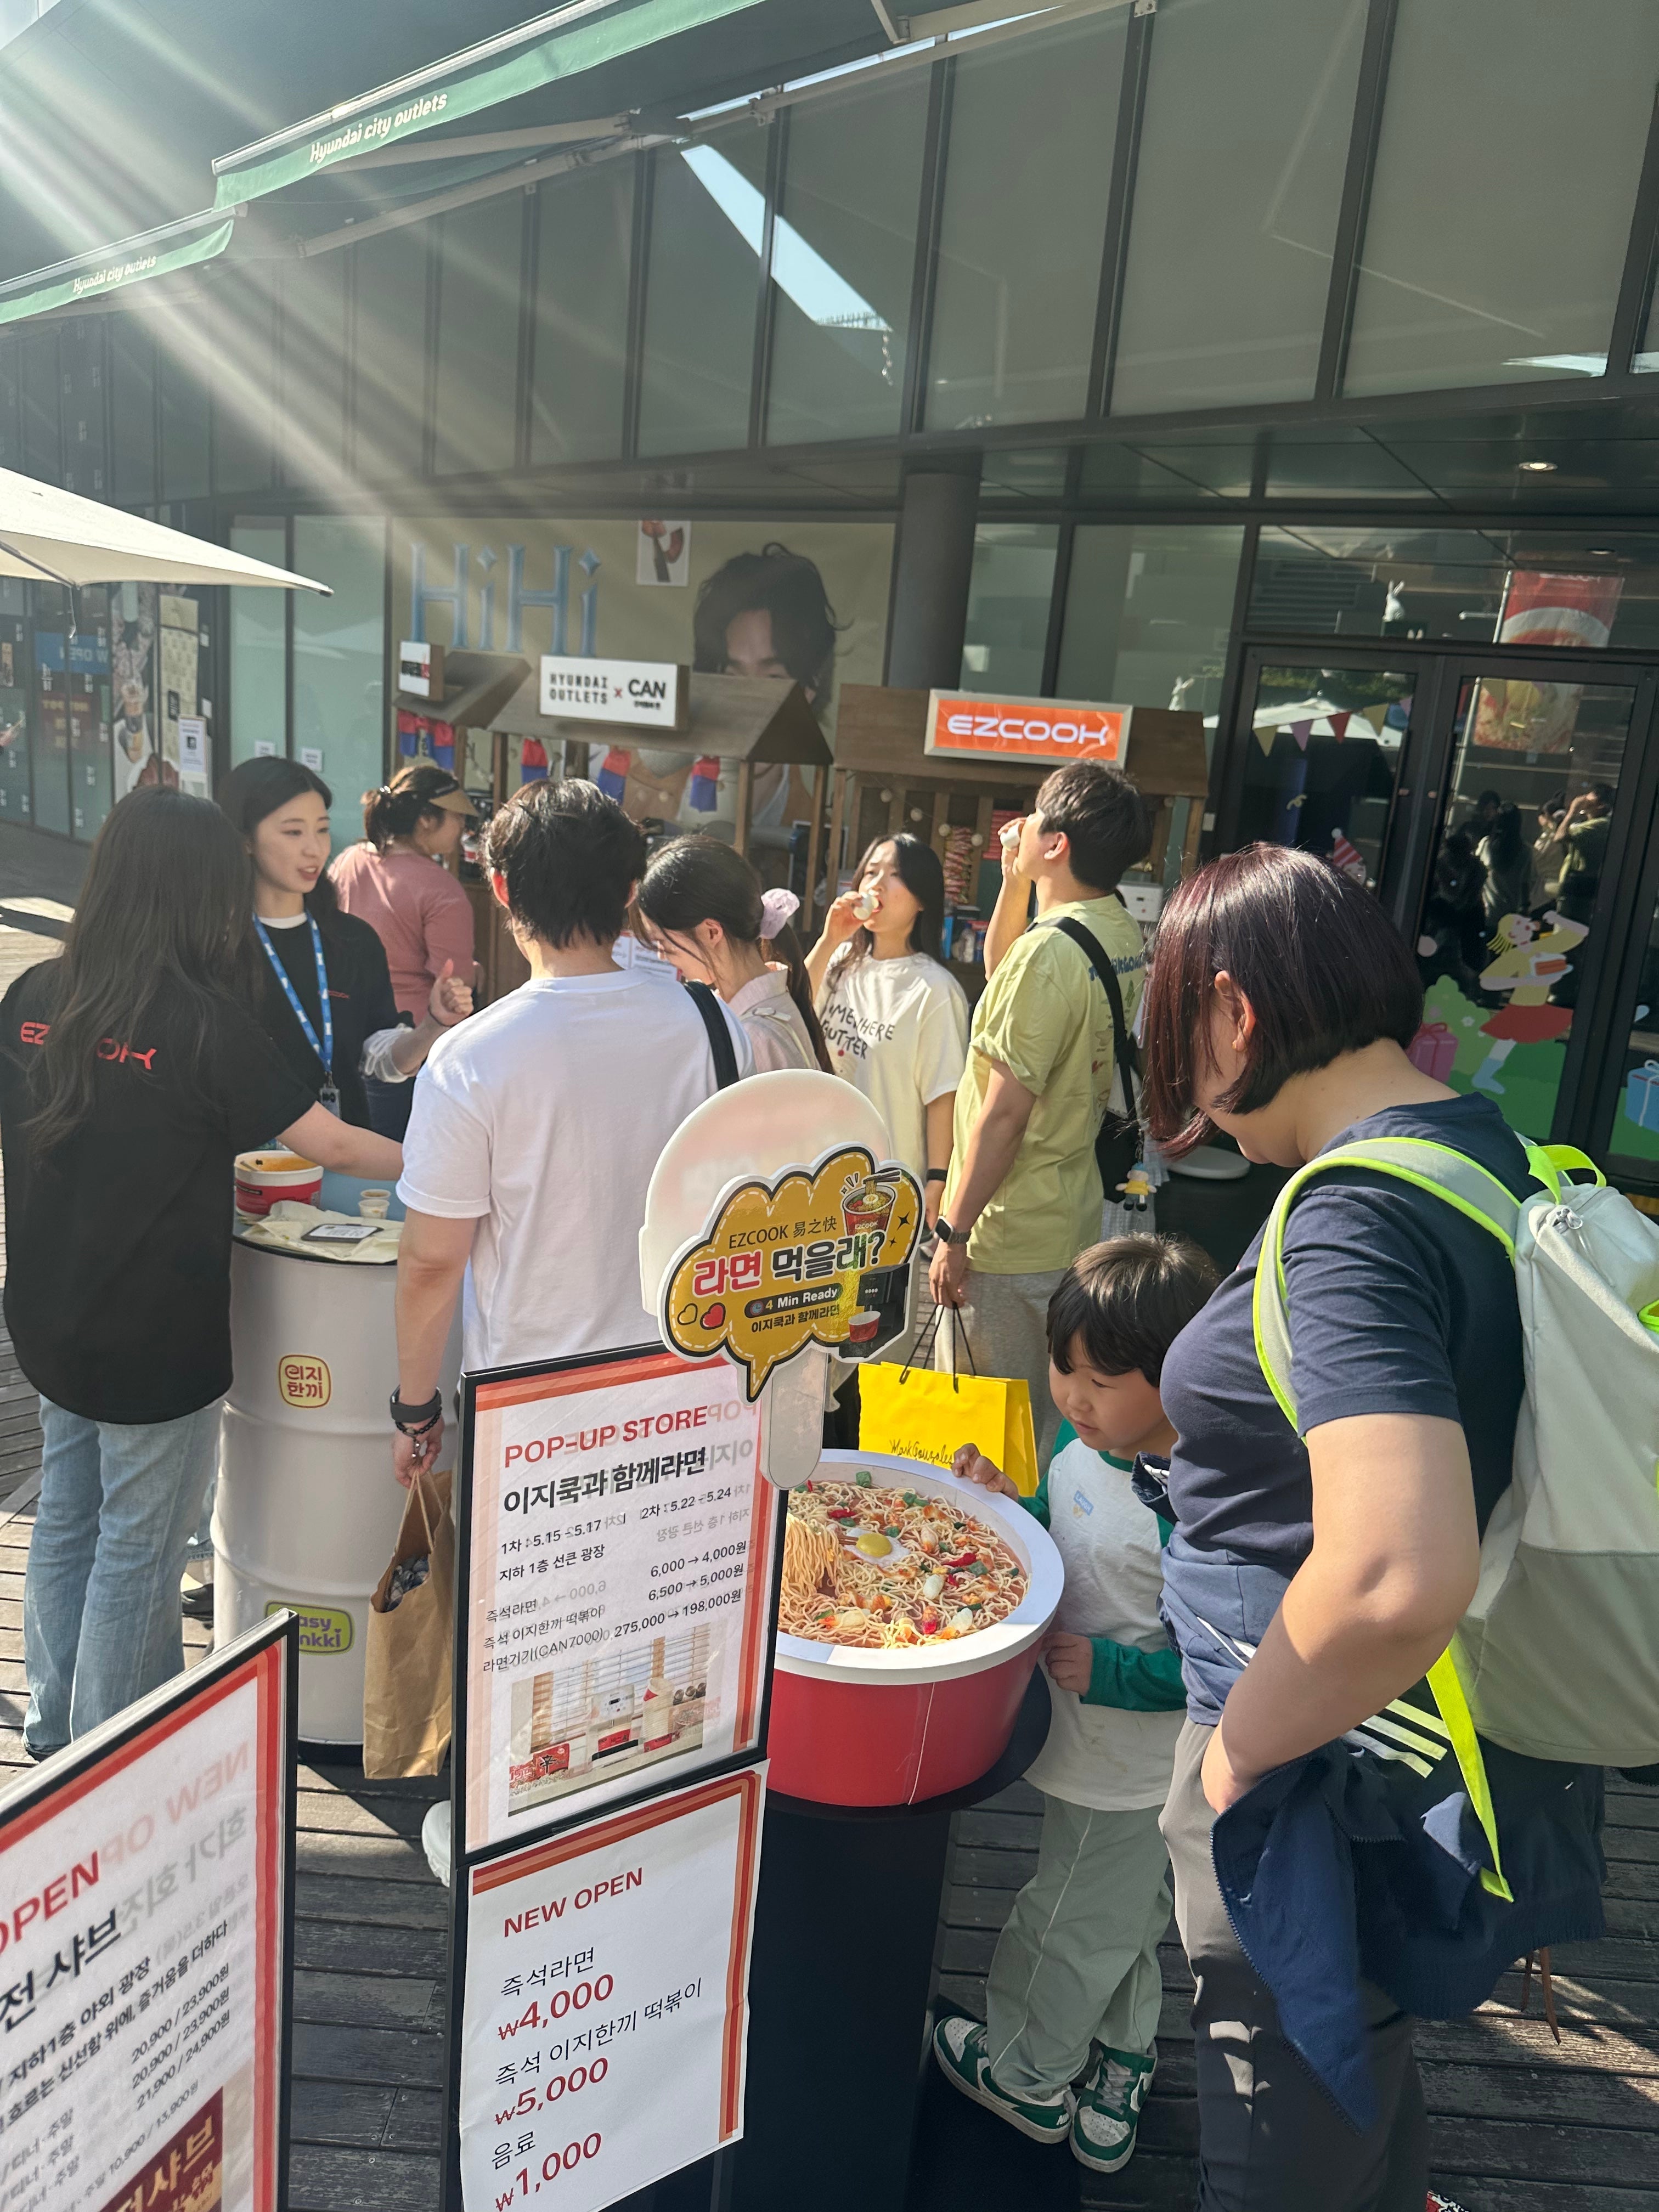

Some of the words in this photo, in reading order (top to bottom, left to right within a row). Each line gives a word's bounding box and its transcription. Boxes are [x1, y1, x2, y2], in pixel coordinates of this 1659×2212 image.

[309, 123, 363, 163] Hyundai
[364, 117, 392, 138] city
[394, 94, 448, 127] outlets
[72, 269, 106, 295] Hyundai
[106, 266, 124, 282] city
[124, 256, 157, 276] outlets
[410, 543, 601, 657] HiHi
[549, 689, 608, 705] OUTLETS
[550, 673, 609, 689] HYUNDAI
[628, 678, 667, 699] CAN
[947, 713, 1109, 746] EZCOOK
[20, 1022, 157, 1070] EZOK
[729, 1224, 789, 1250] EZCOOK
[793, 1216, 837, 1238] 易之快
[854, 1221, 878, 1230] EZCOOK
[693, 1251, 761, 1296] 라면
[772, 1231, 886, 1282] 먹을래?
[751, 1316, 796, 1333] 이지쿡과
[765, 1301, 774, 1311] 4
[777, 1295, 799, 1308] Min
[802, 1288, 838, 1305] Ready
[505, 1425, 617, 1468] POP-UP
[623, 1405, 708, 1442] STORE
[504, 1469, 608, 1515] 이지쿡과
[612, 1446, 707, 1493] 함께라면
[641, 1504, 661, 1519] 2차
[670, 1496, 695, 1512] 5.22
[707, 1487, 731, 1503] 5.24
[499, 1565, 524, 1581] 지하
[529, 1559, 549, 1574] 1층
[553, 1551, 577, 1569] 선큰
[580, 1544, 606, 1562] 광장
[501, 1538, 522, 1555] 1차
[533, 1529, 561, 1547] 5.15
[574, 1519, 602, 1537] 5.17
[483, 1632, 509, 1650] 즉석
[648, 1582, 683, 1601] 6,500
[699, 1563, 744, 1587] 5,000원
[486, 1599, 537, 1623] 즉석라면
[650, 1558, 685, 1578] 6,000
[702, 1541, 747, 1563] 4,000원
[298, 1615, 332, 1632] asy
[298, 1628, 342, 1647] nkki
[614, 1613, 665, 1639] 275,000
[682, 1588, 742, 1618] 198,000원
[503, 1897, 567, 1938] NEW
[574, 1867, 643, 1910] OPEN
[46, 1908, 122, 1989] 샤브
[500, 1946, 595, 1997] 즉석라면
[58, 2032, 103, 2084] 신선함
[192, 1919, 228, 1963] 더하다
[80, 1985, 114, 2026] 야외
[119, 1955, 151, 1995] 광장
[132, 2017, 173, 2065] 20,900
[182, 1962, 229, 2023] 23,900원
[132, 2042, 173, 2090] 20,900
[182, 1986, 229, 2042] 23,900원
[495, 2051, 541, 2085] 즉석
[549, 2010, 637, 2062] 이지한끼
[644, 1977, 702, 2020] 떡볶이
[137, 2064, 176, 2111] 21,900
[185, 2009, 230, 2063] 24,900원
[491, 2131, 536, 2170] 음료
